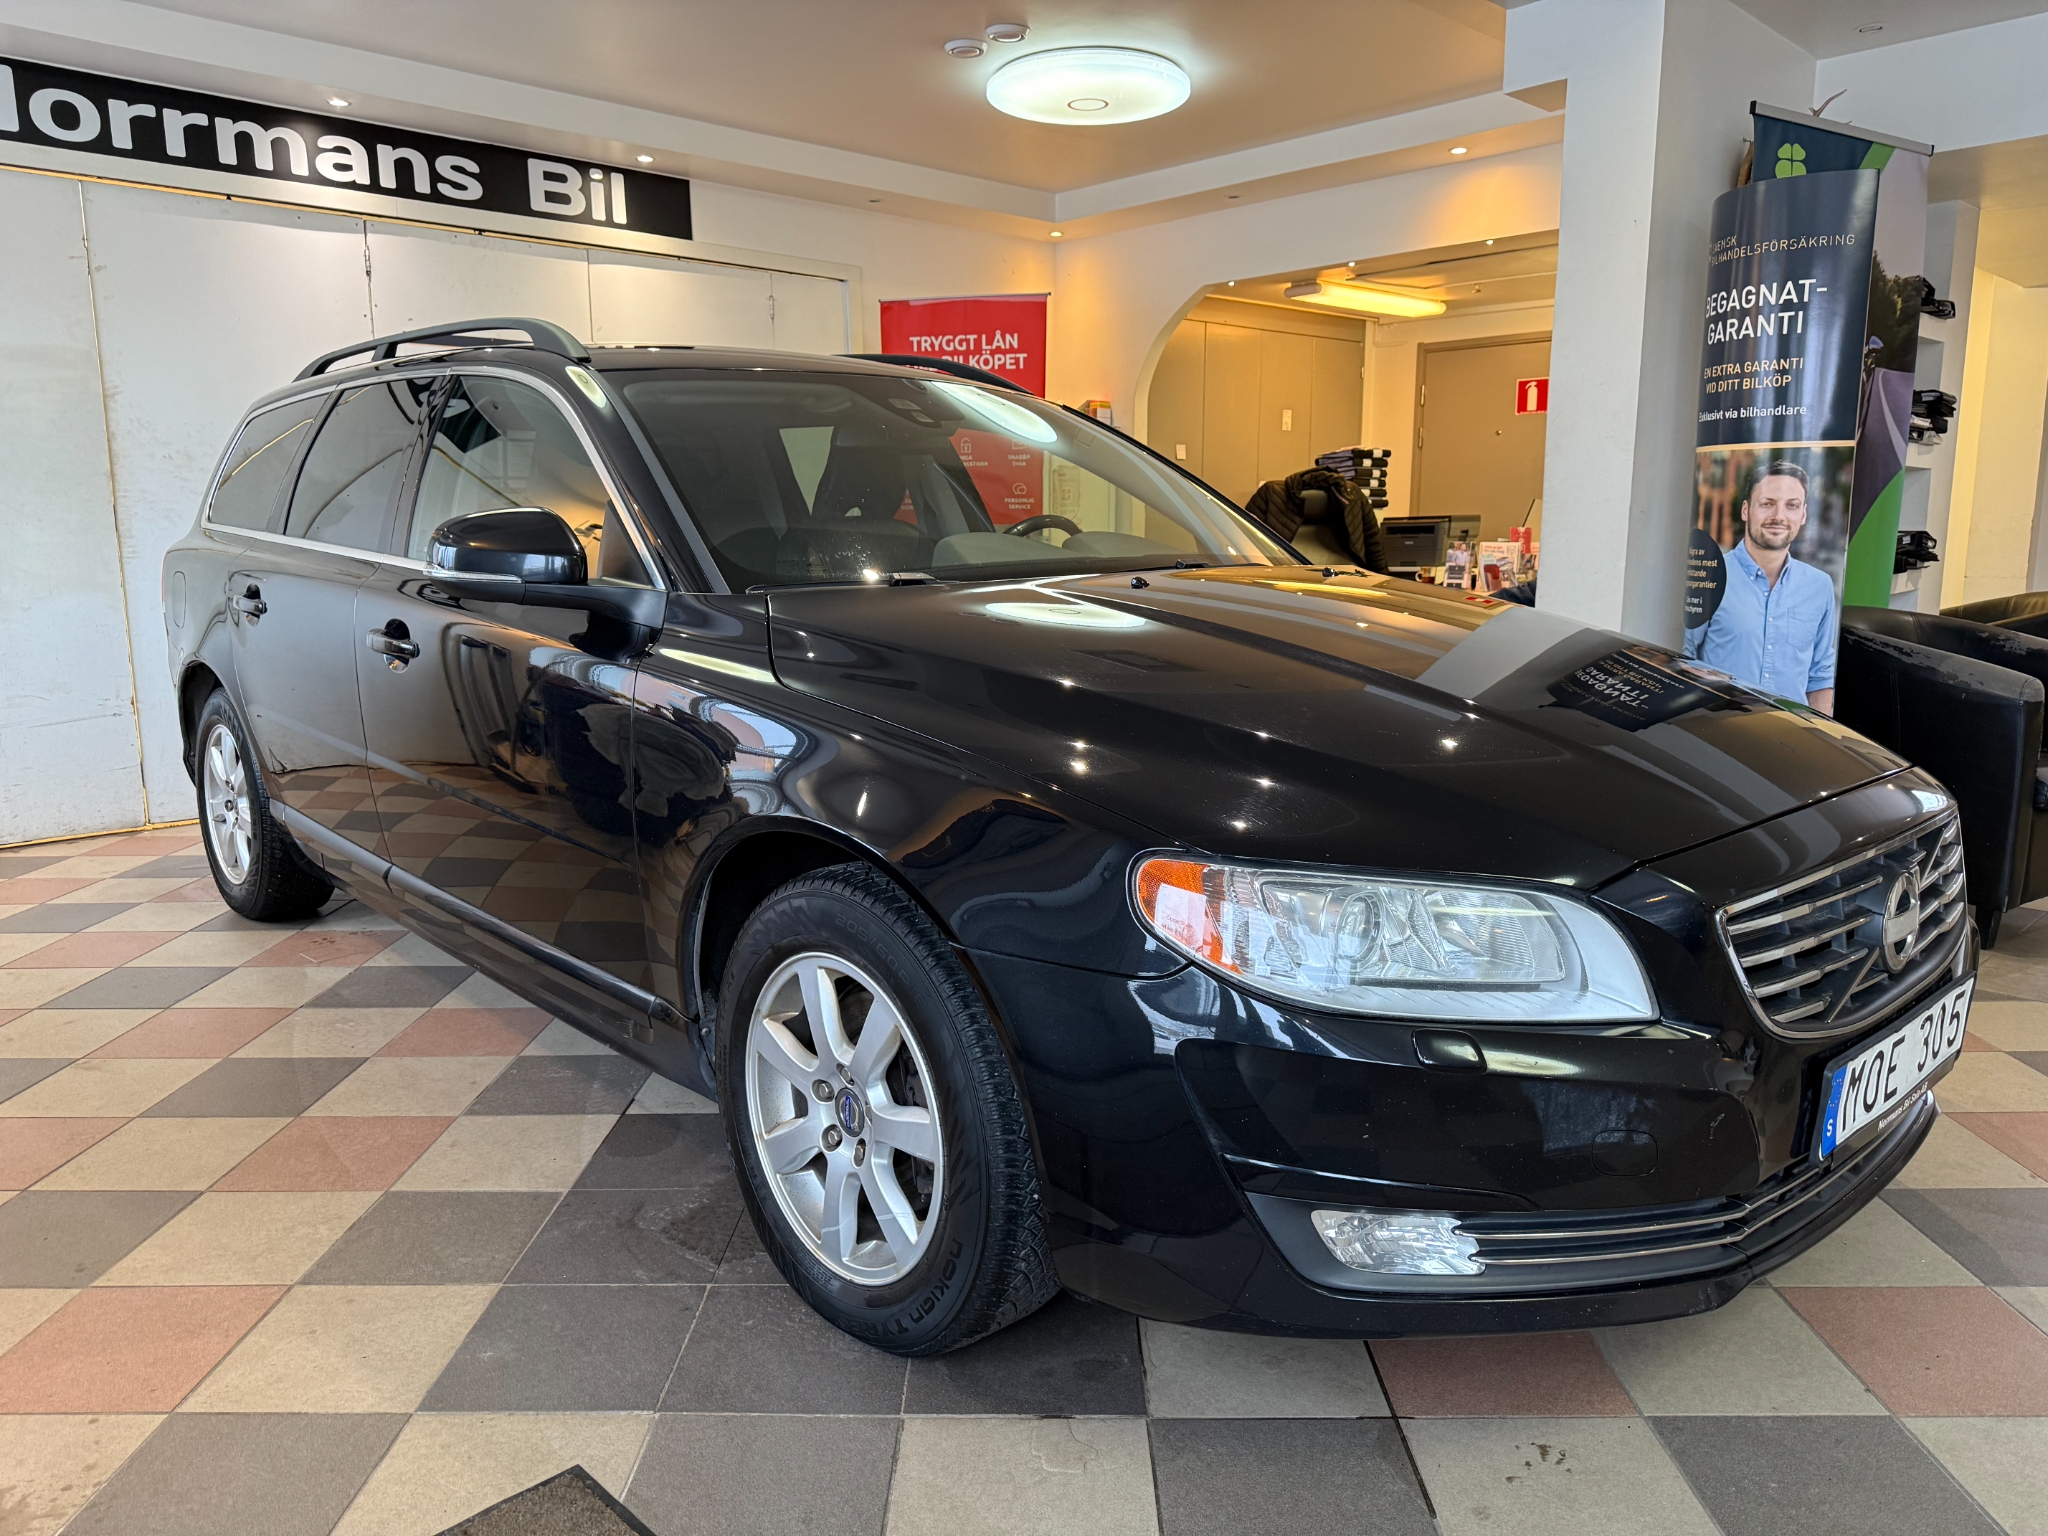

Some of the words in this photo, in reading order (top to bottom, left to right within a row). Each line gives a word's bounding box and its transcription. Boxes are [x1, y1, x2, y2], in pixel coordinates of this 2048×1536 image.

[527, 158, 627, 224] Bil
[1705, 278, 1828, 319] BEGAGNAT-
[1707, 310, 1804, 345] GARANTI
[909, 334, 978, 352] TRYGGT
[981, 330, 1018, 350] LÅN
[1704, 366, 1712, 379] EN
[1712, 363, 1741, 377] EXTRA
[1744, 358, 1804, 373] GARANTI
[1706, 381, 1717, 394] VID
[1718, 379, 1741, 393] DITT
[1742, 373, 1792, 390] BILKÖP
[1725, 408, 1738, 419] via
[1740, 405, 1807, 418] bilhandlare
[1842, 1034, 1906, 1132] MOE
[1917, 989, 1966, 1073] 305
[1826, 1118, 1833, 1137] S
